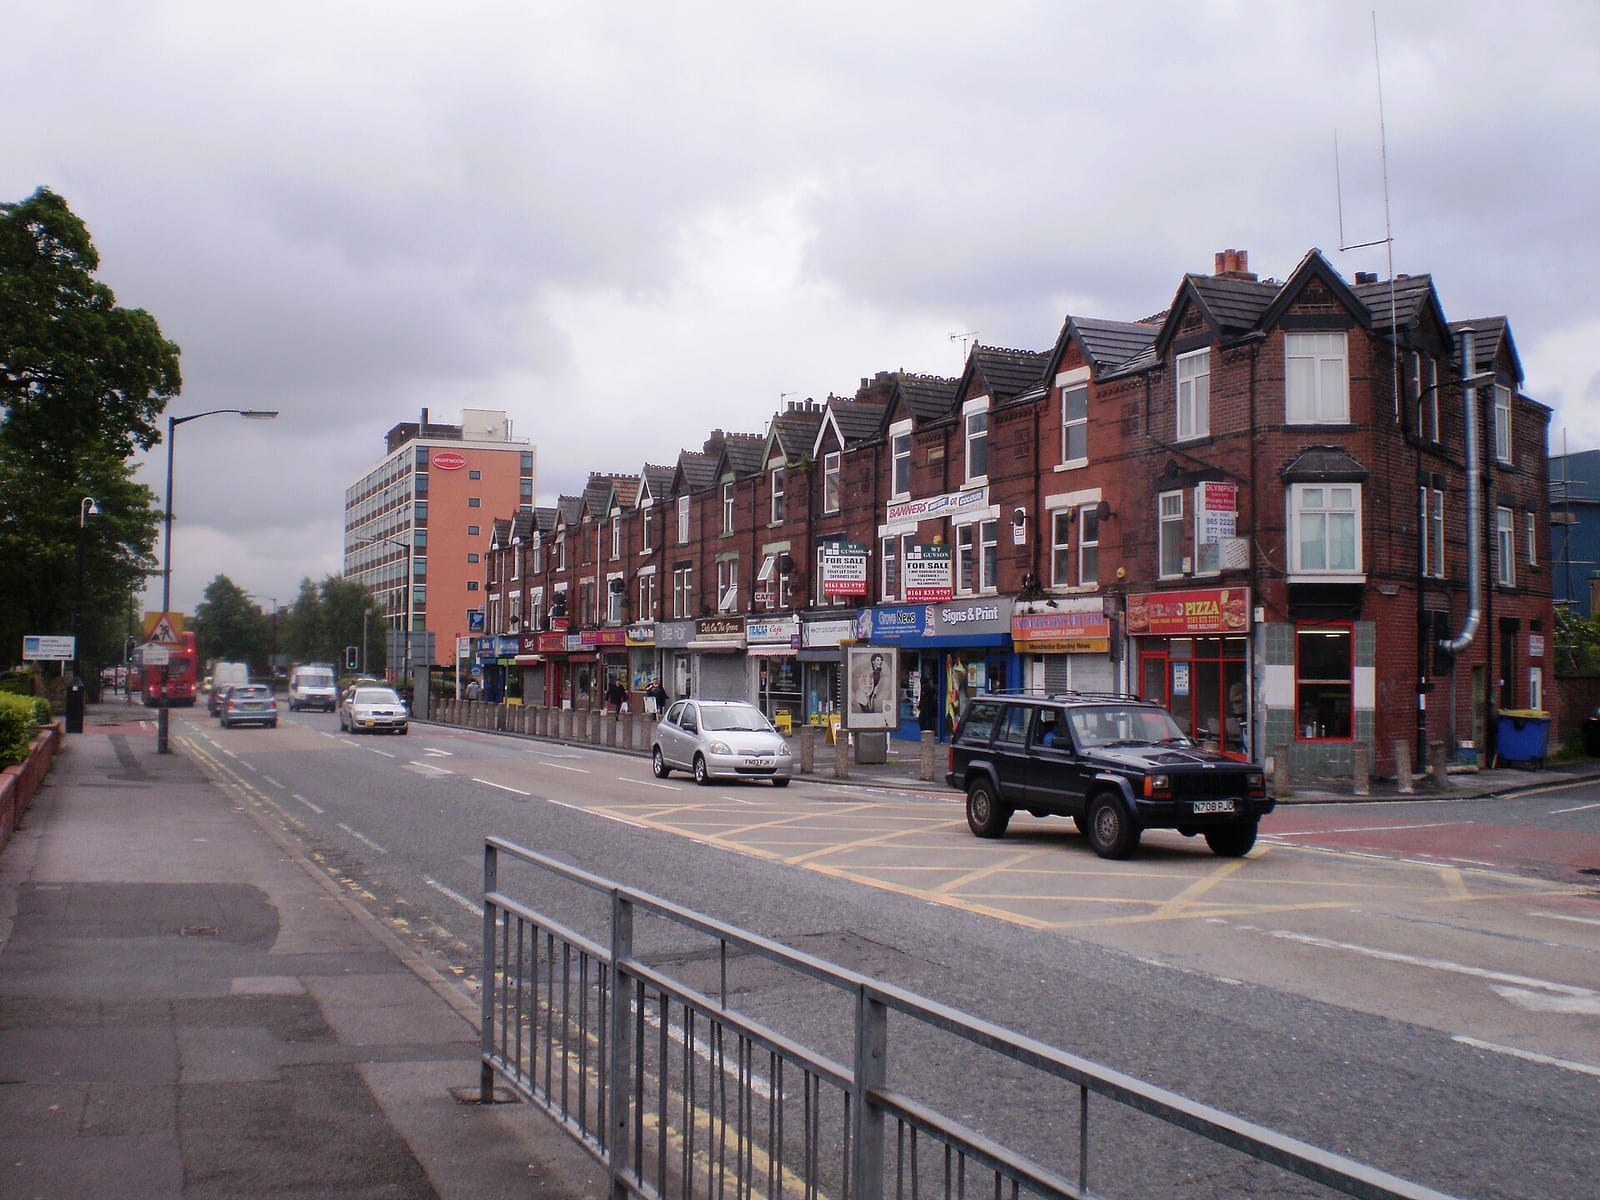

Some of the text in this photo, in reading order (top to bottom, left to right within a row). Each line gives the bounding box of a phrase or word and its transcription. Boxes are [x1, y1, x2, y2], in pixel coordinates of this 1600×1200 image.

[1206, 484, 1233, 492] OLYMPIC
[889, 501, 929, 519] BANNERS
[848, 557, 865, 565] SALE
[942, 606, 998, 625] Signs & Print
[1185, 601, 1219, 616] PIZZA
[879, 610, 916, 625] Grove News
